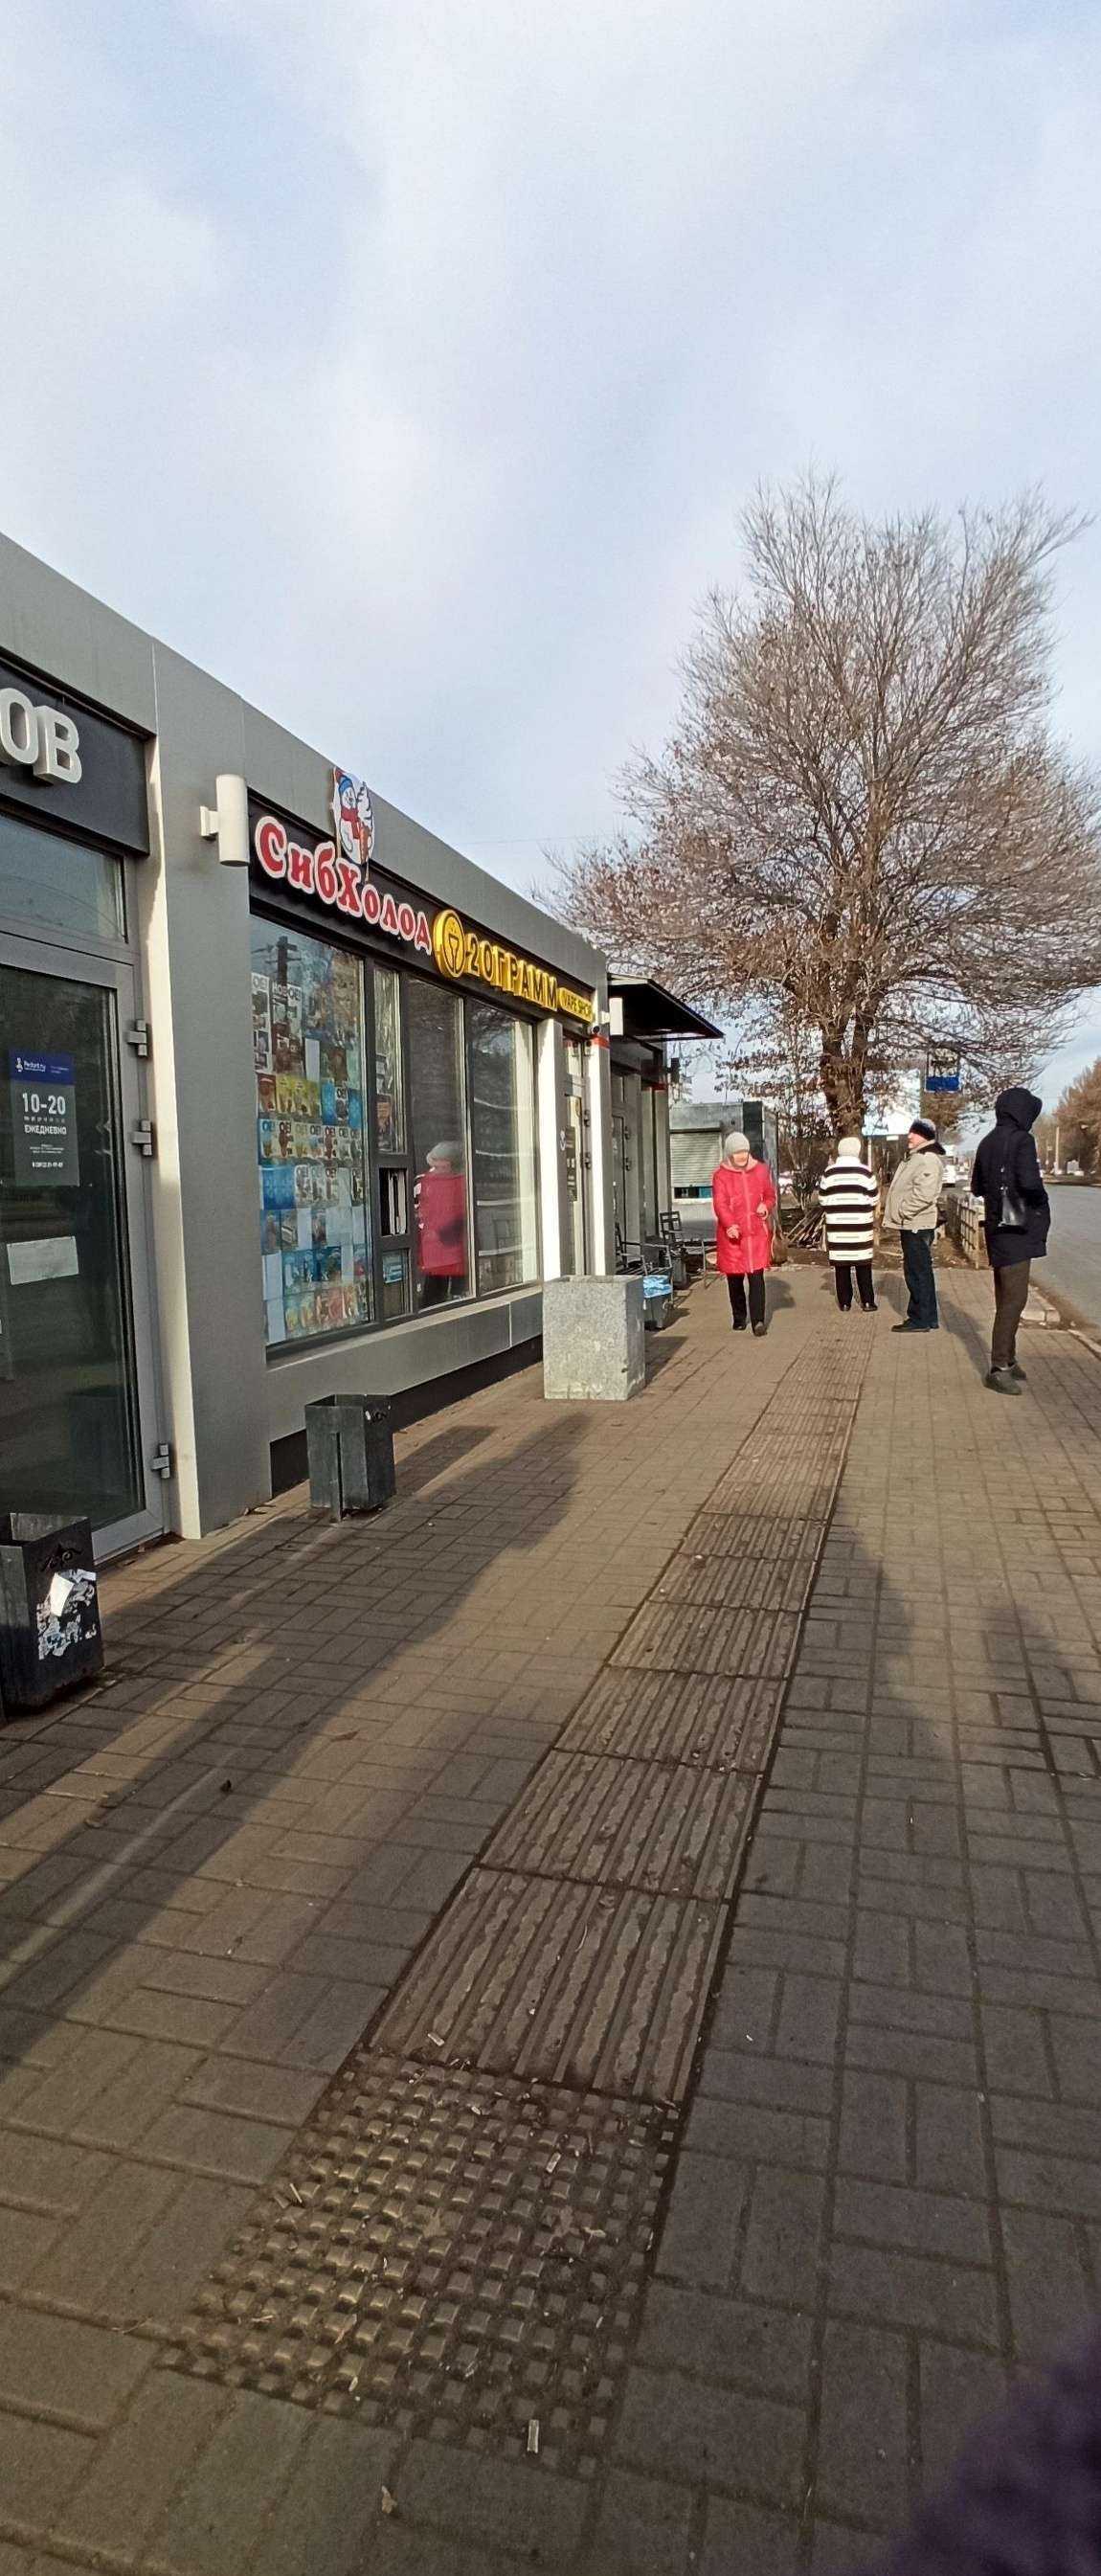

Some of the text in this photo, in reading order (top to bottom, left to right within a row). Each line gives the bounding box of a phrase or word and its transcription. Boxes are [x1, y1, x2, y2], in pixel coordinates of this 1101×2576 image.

[255, 816, 432, 956] СибХолод
[22, 1092, 66, 1116] 10-20
[24, 1124, 67, 1135] ЕЖЕДНЕВНО
